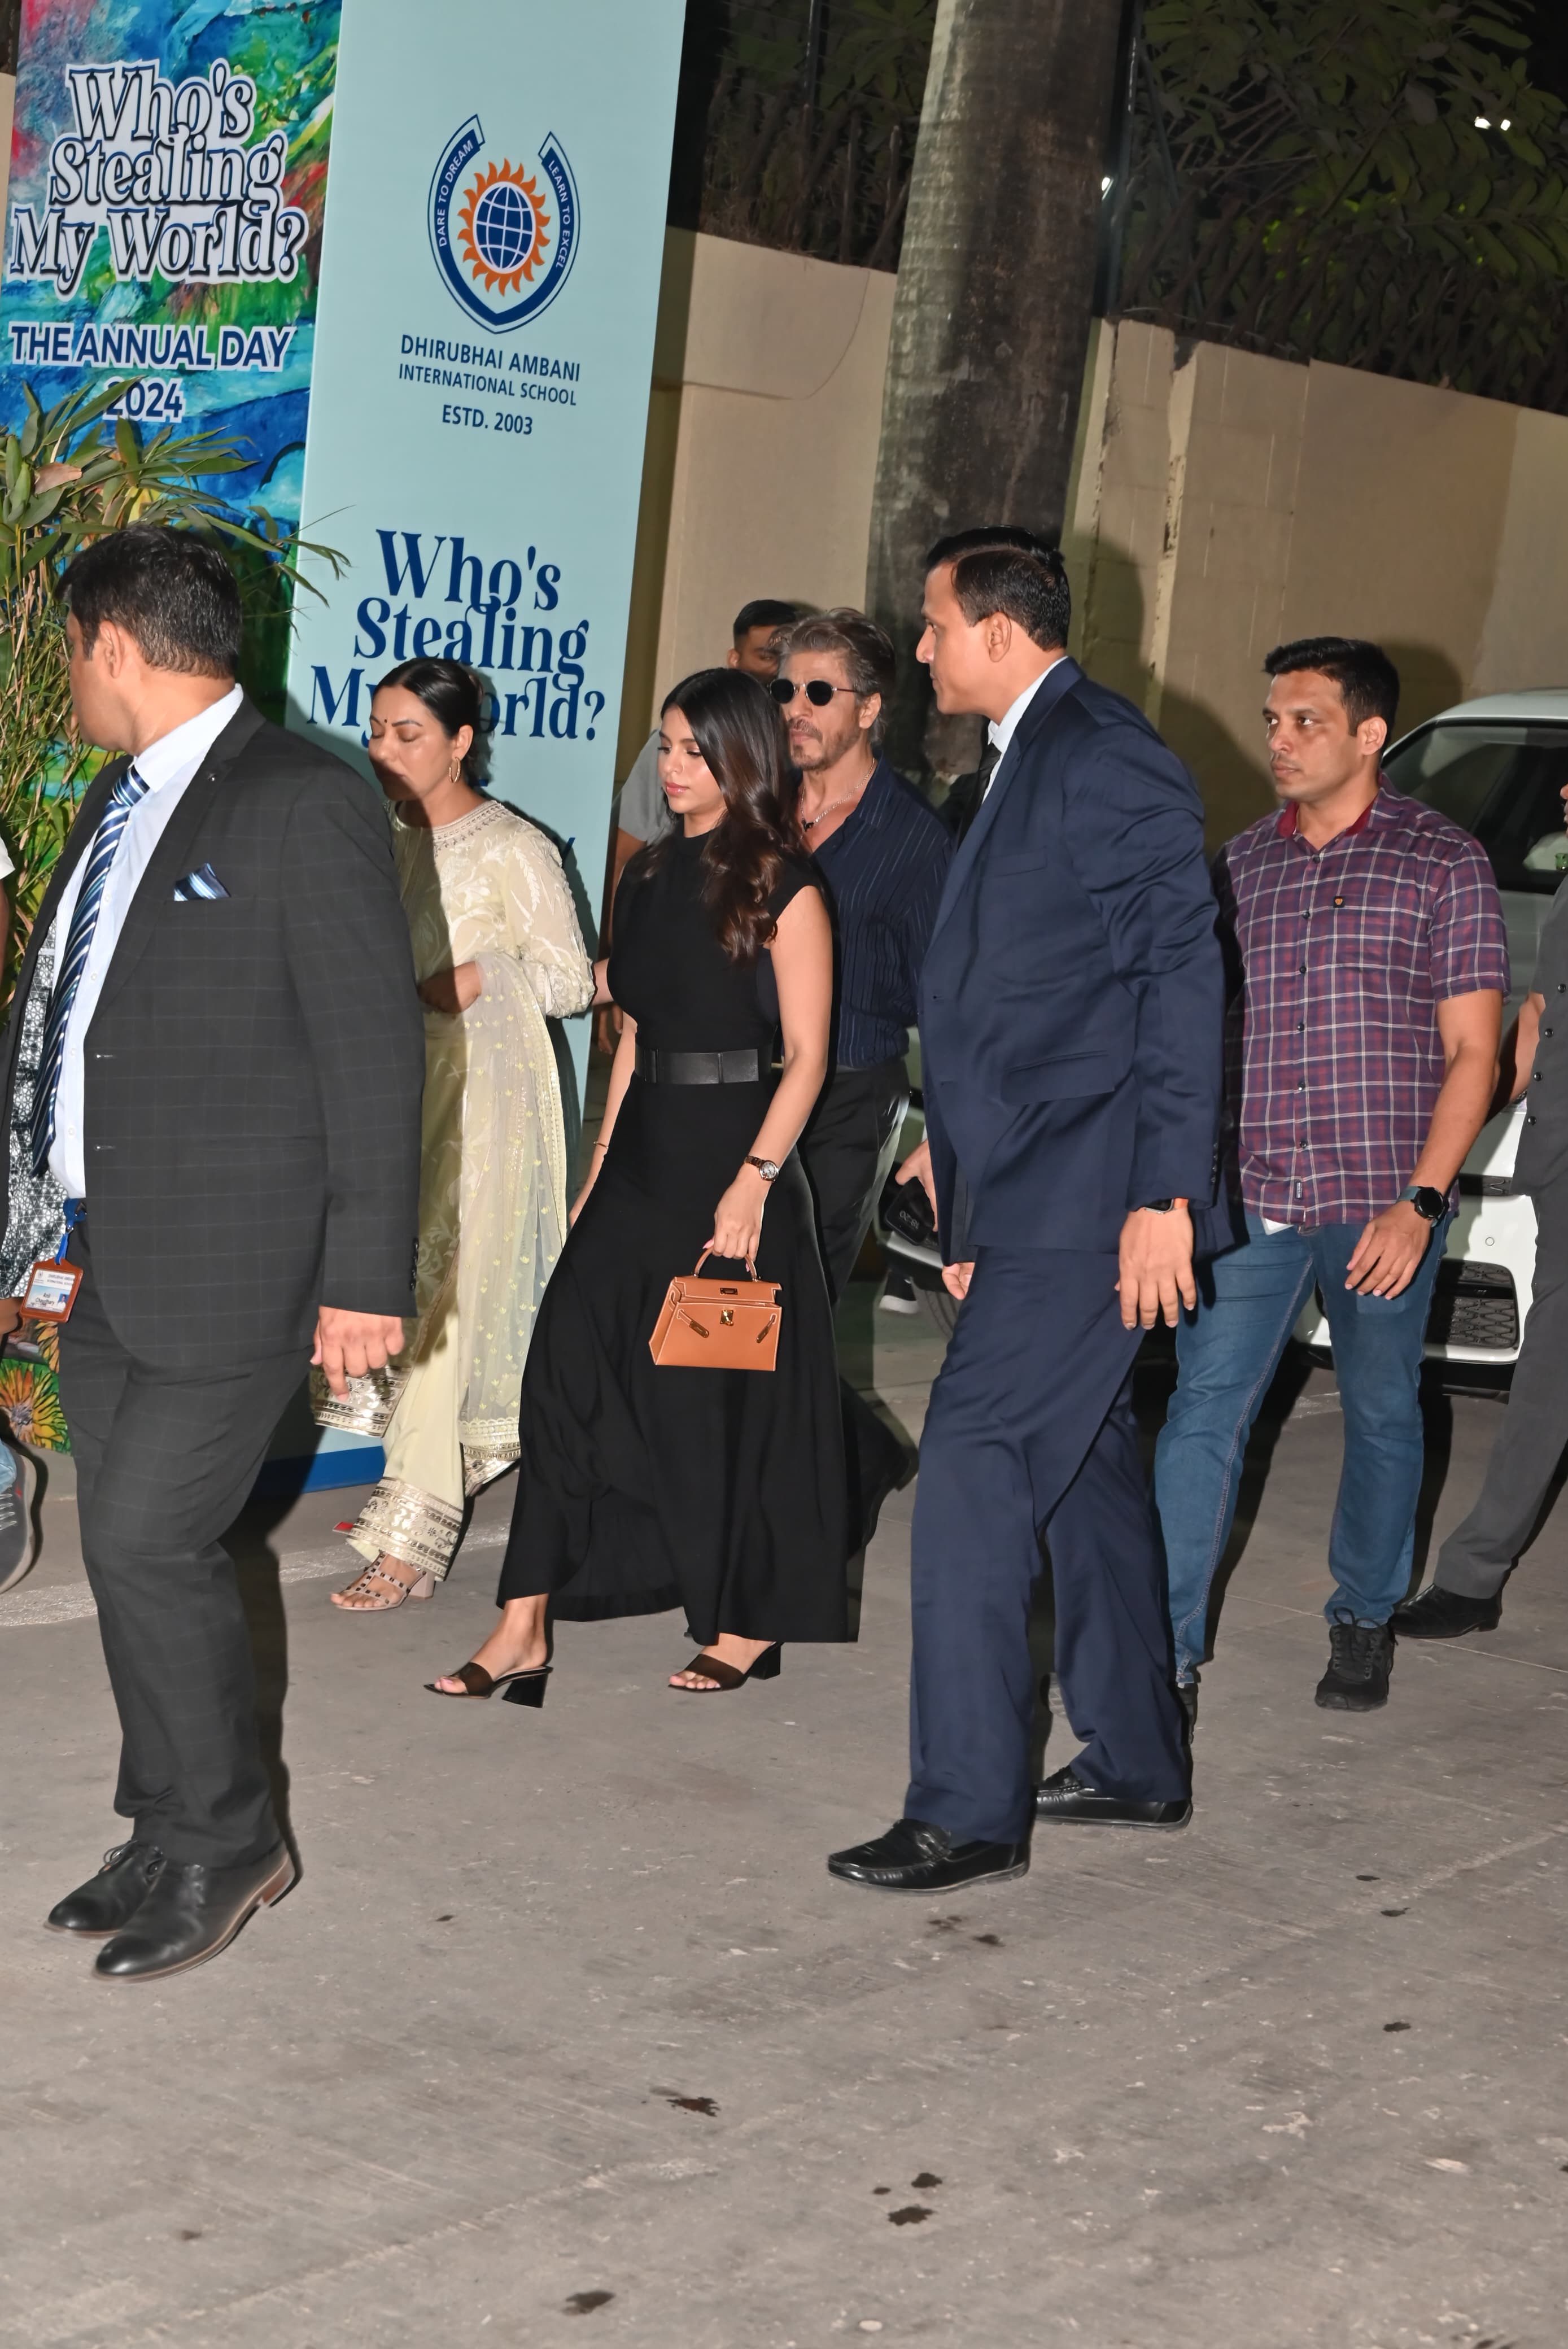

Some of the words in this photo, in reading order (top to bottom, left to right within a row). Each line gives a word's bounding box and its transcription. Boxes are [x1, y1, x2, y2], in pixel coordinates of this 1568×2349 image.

[68, 61, 253, 146] Who's
[51, 123, 285, 220] Stealing
[445, 139, 474, 183] DREAM
[548, 160, 569, 203] LEARN
[438, 185, 449, 204] TO
[562, 206, 571, 225] TO
[438, 209, 447, 247] DARE
[556, 230, 570, 268] EXCEL
[10, 208, 94, 295] My
[107, 206, 305, 276] World?
[11, 326, 70, 362] THE
[77, 325, 212, 366] ANNUAL
[221, 327, 291, 367] DAY
[401, 334, 503, 370] DHIRUBHAI
[509, 353, 580, 382] AMBANI
[106, 382, 183, 418] 2024
[399, 363, 515, 396] INTERNATIONAL
[520, 383, 576, 406] SCHOOL
[442, 404, 489, 429] ESTD.
[494, 412, 533, 435] 2003
[376, 529, 561, 614] Who's
[353, 595, 589, 692] Stealing
[480, 676, 605, 741] orld?
